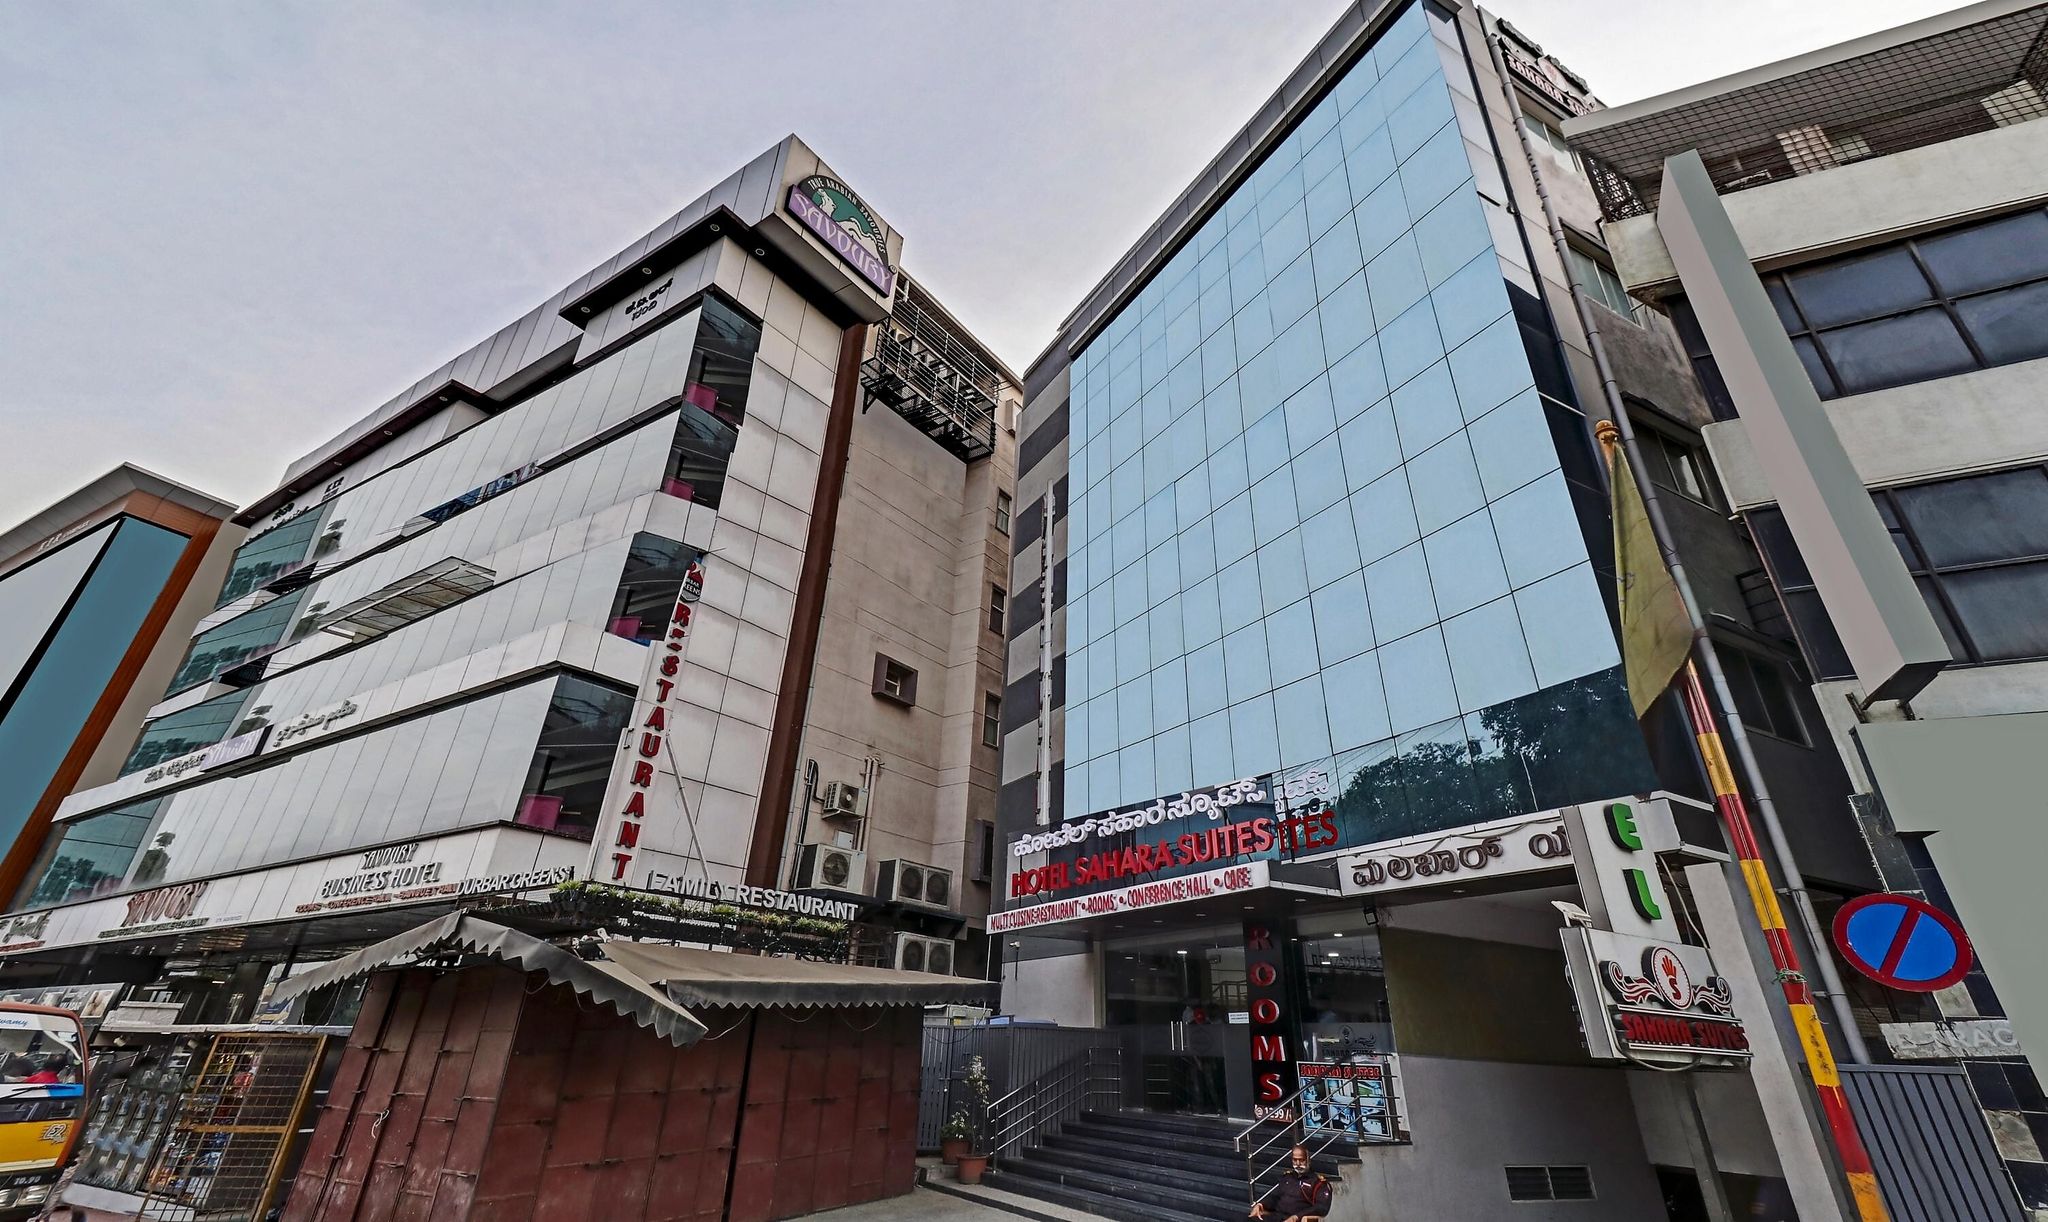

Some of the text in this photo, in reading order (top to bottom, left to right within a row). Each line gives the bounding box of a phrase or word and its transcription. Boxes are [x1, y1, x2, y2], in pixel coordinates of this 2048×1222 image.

[795, 193, 891, 287] SAVOURY
[826, 179, 858, 205] ARABIAN
[859, 206, 886, 254] SAVOURIES
[321, 862, 442, 899] BUSINESS HOTEL
[361, 843, 419, 870] SAVOURY
[1011, 818, 1275, 898] HOTEL SAHARA SUITES
[1350, 835, 1504, 887] ಮಲಬಾರ್
[120, 881, 210, 927] SAVOURY
[456, 867, 571, 896] DURBAR GREENS
[736, 884, 859, 921] RESTAURANT
[1036, 900, 1080, 924] RESTAURANT
[1088, 894, 1117, 914] ROOMS
[1127, 880, 1186, 908] CONFERENCE
[1186, 875, 1214, 898] HALL
[1224, 867, 1252, 890] CAFE
[1251, 926, 1287, 1100] ROOMS
[1622, 1013, 1750, 1050] SAHARA SUITES
